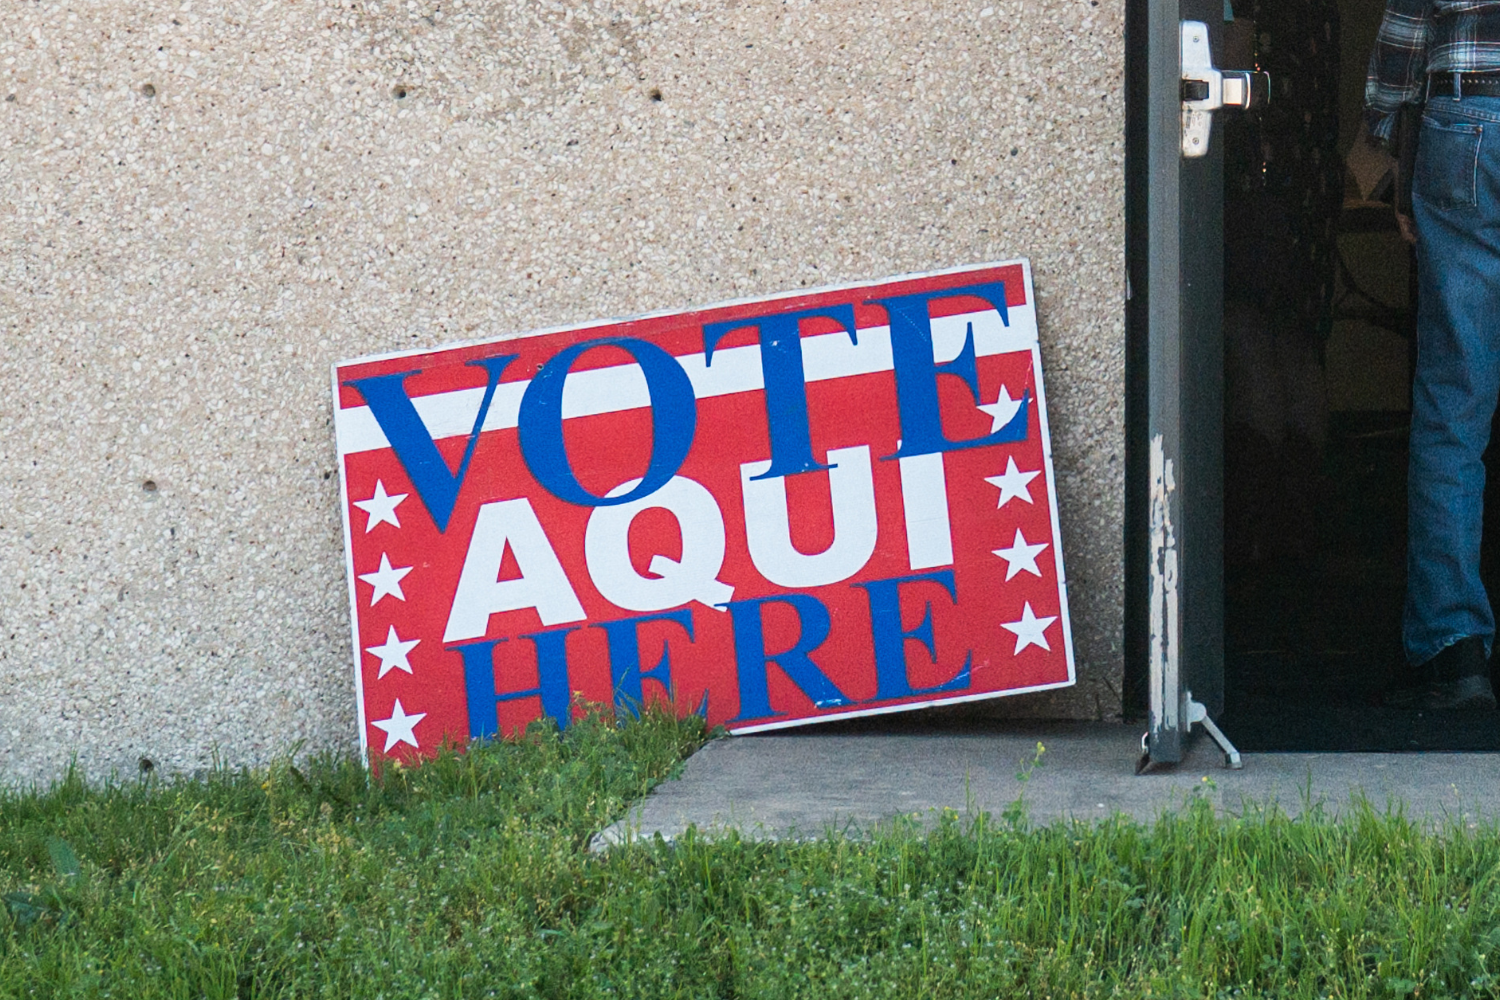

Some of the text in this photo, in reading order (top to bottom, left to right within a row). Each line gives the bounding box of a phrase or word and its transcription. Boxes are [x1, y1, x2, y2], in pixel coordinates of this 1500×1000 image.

[343, 280, 1030, 535] VOTE
[443, 440, 954, 644] AQUI
[444, 570, 973, 742] HERE
